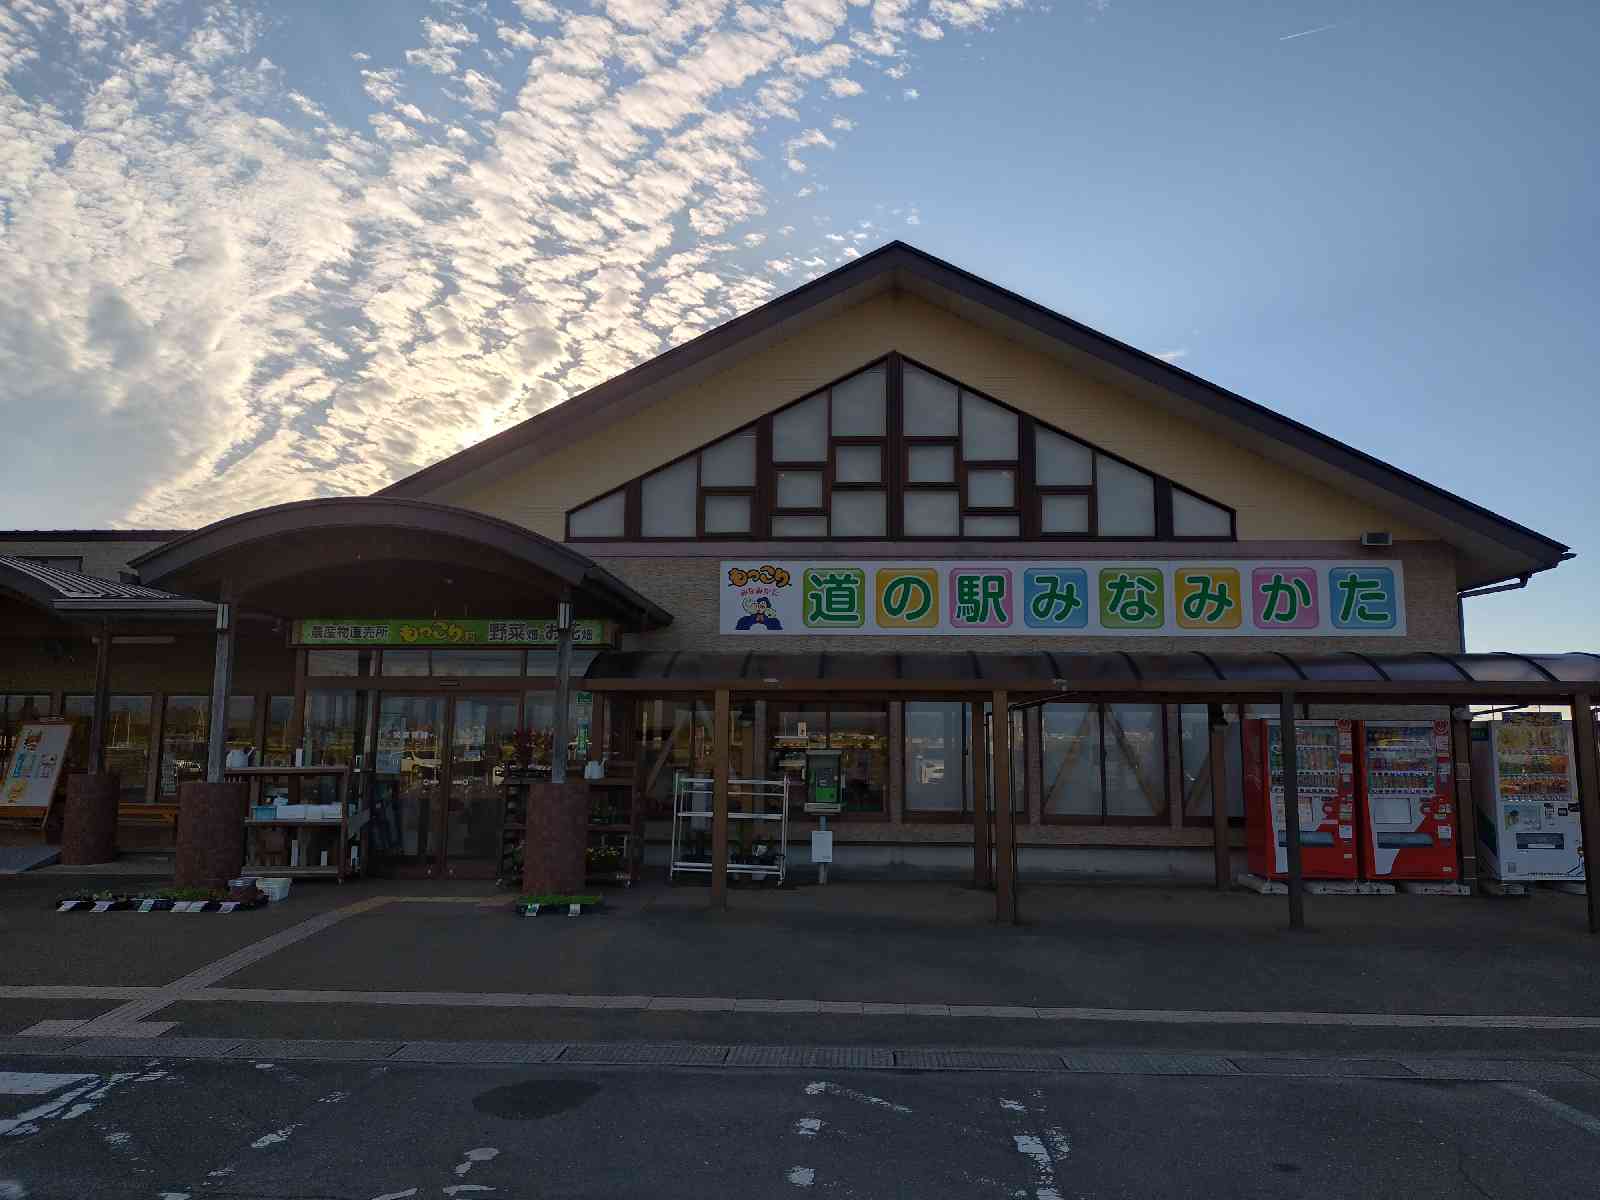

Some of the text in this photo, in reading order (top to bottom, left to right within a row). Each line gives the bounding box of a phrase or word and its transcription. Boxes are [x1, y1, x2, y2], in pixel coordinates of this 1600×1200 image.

[808, 572, 1391, 625] 道の駅みなみかた
[312, 623, 389, 640] 農産物直売所
